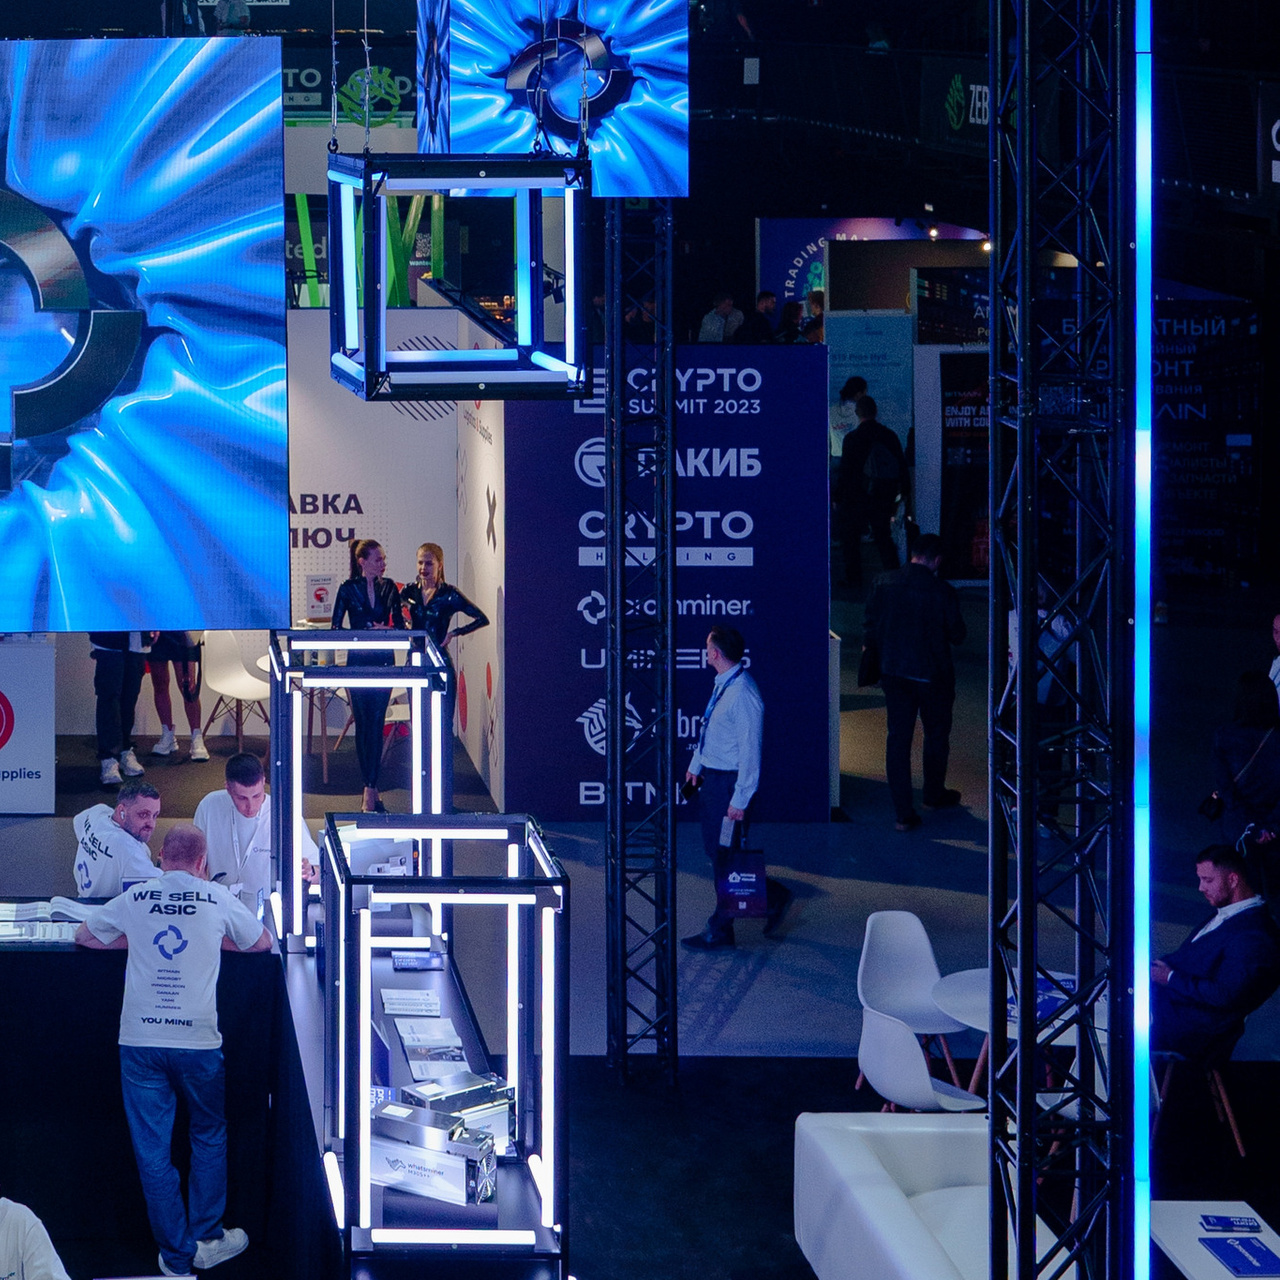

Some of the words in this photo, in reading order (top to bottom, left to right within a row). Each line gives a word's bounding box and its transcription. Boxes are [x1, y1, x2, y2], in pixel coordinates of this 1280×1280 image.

[627, 368, 763, 392] CYPTO
[628, 399, 707, 414] SUMIT
[713, 399, 761, 414] 2023
[88, 834, 113, 859] SELL
[133, 890, 162, 903] WE
[168, 891, 217, 904] SELL
[149, 904, 197, 915] ASIC
[141, 1017, 162, 1025] YOU
[164, 1018, 193, 1027] MINE
[407, 1163, 444, 1176] whatsminer
